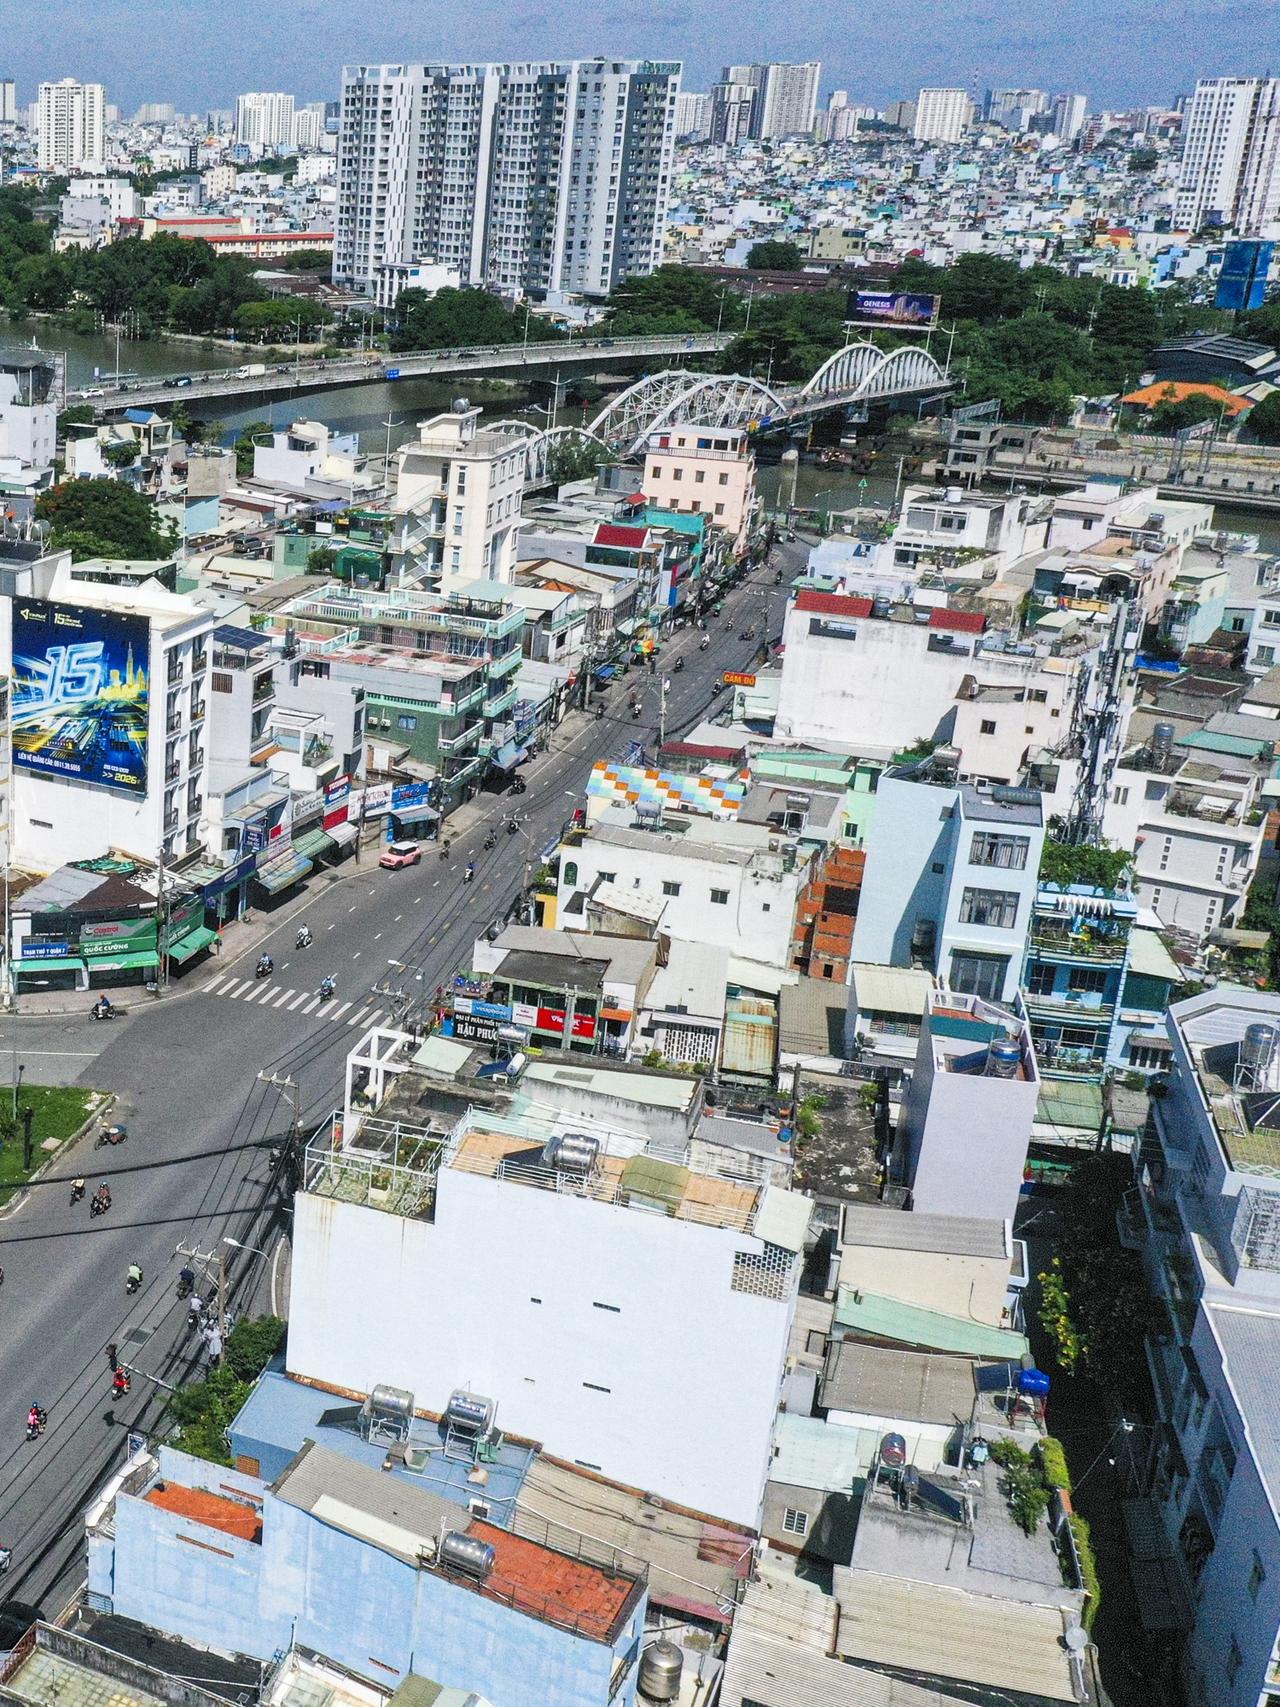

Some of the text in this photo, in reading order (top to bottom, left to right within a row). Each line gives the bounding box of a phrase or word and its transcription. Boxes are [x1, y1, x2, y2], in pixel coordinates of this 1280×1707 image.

[863, 300, 891, 308] GENESIS
[44, 641, 104, 702] 15
[115, 772, 138, 785] 2026
[94, 925, 119, 934] Castrol
[84, 945, 103, 954] QUỐC
[457, 1022, 475, 1038] HẬU
